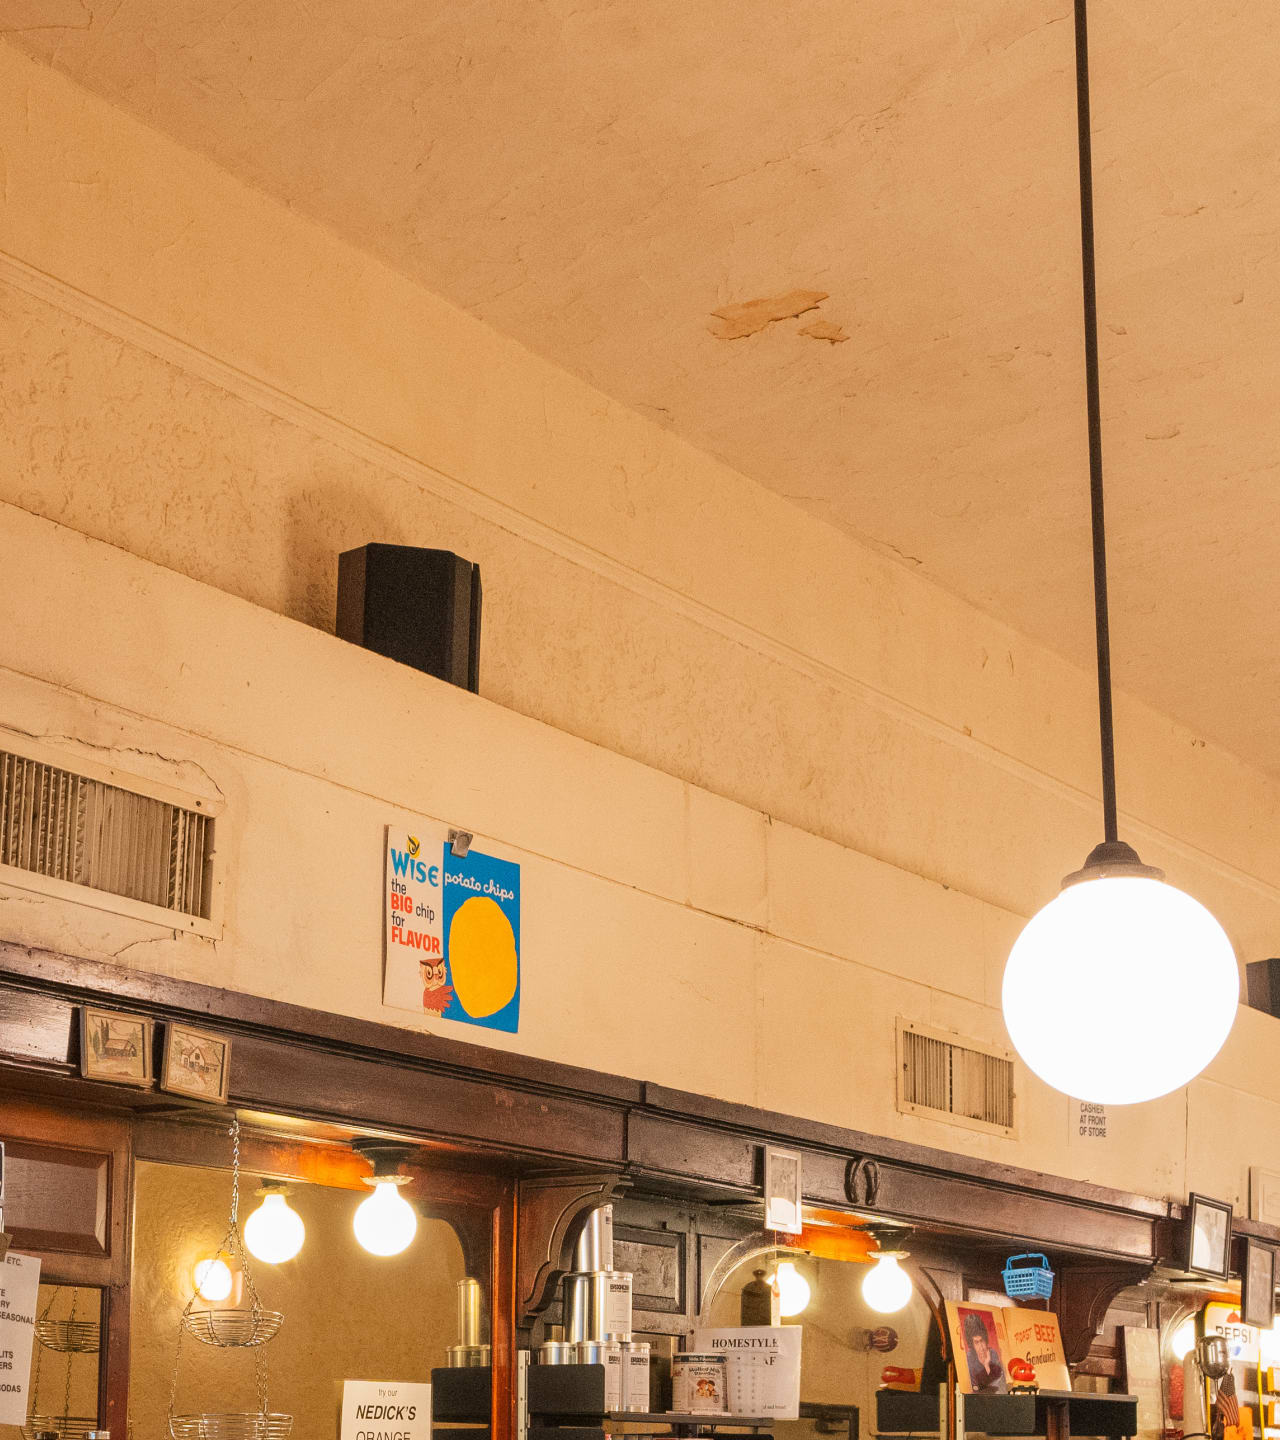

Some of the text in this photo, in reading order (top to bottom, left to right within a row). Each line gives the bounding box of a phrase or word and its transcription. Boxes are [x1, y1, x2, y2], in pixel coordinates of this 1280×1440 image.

[391, 879, 406, 895] the
[445, 872, 481, 892] potato
[483, 880, 514, 902] chips
[391, 893, 435, 924] BIG chip
[391, 910, 406, 928] for
[391, 926, 441, 955] FLAVOR
[1080, 1102, 1105, 1114] CASHIER
[1080, 1115, 1106, 1126] AT FRONT
[1080, 1127, 1106, 1138] OF STORE
[7, 1256, 23, 1267] ETC.
[1034, 1324, 1055, 1343] BEEF
[1216, 1325, 1252, 1344] PEPSI
[712, 1338, 778, 1349] HOMESTYLE
[1026, 1347, 1056, 1365] Sandwich
[355, 1405, 417, 1421] NEDICK'S
